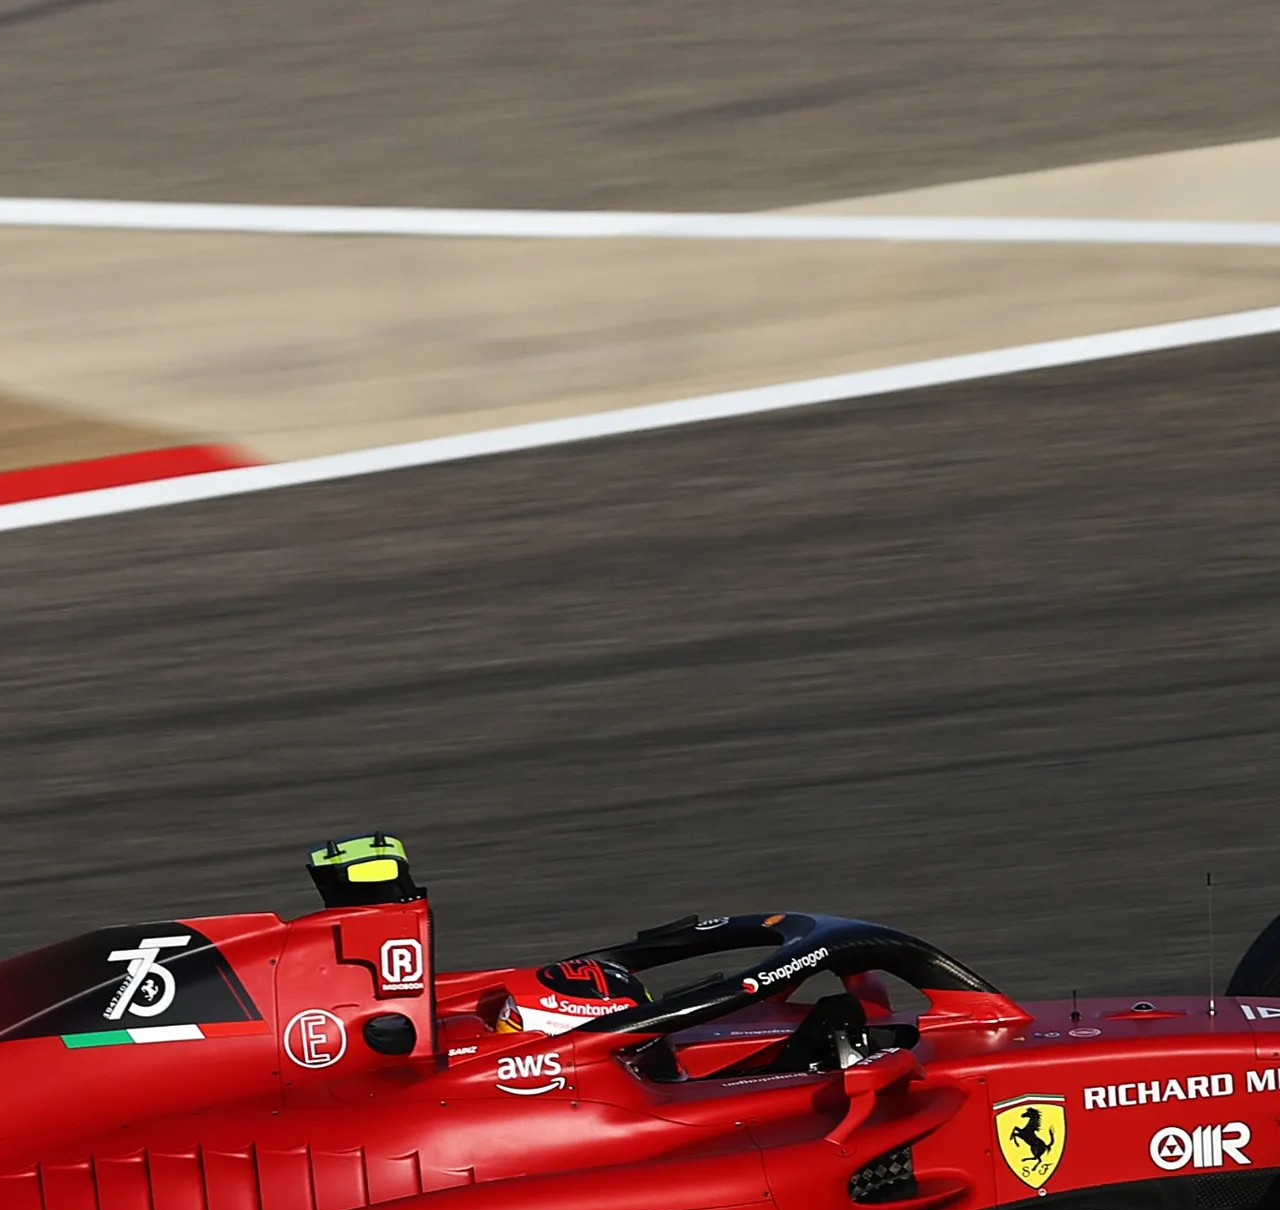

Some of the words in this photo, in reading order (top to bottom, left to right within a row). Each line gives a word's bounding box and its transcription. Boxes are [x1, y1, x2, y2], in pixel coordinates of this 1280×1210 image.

[757, 946, 829, 986] Snapdragon
[448, 1046, 478, 1056] SAINZ
[496, 1052, 562, 1081] aws
[1084, 1074, 1234, 1110] RICHARD
